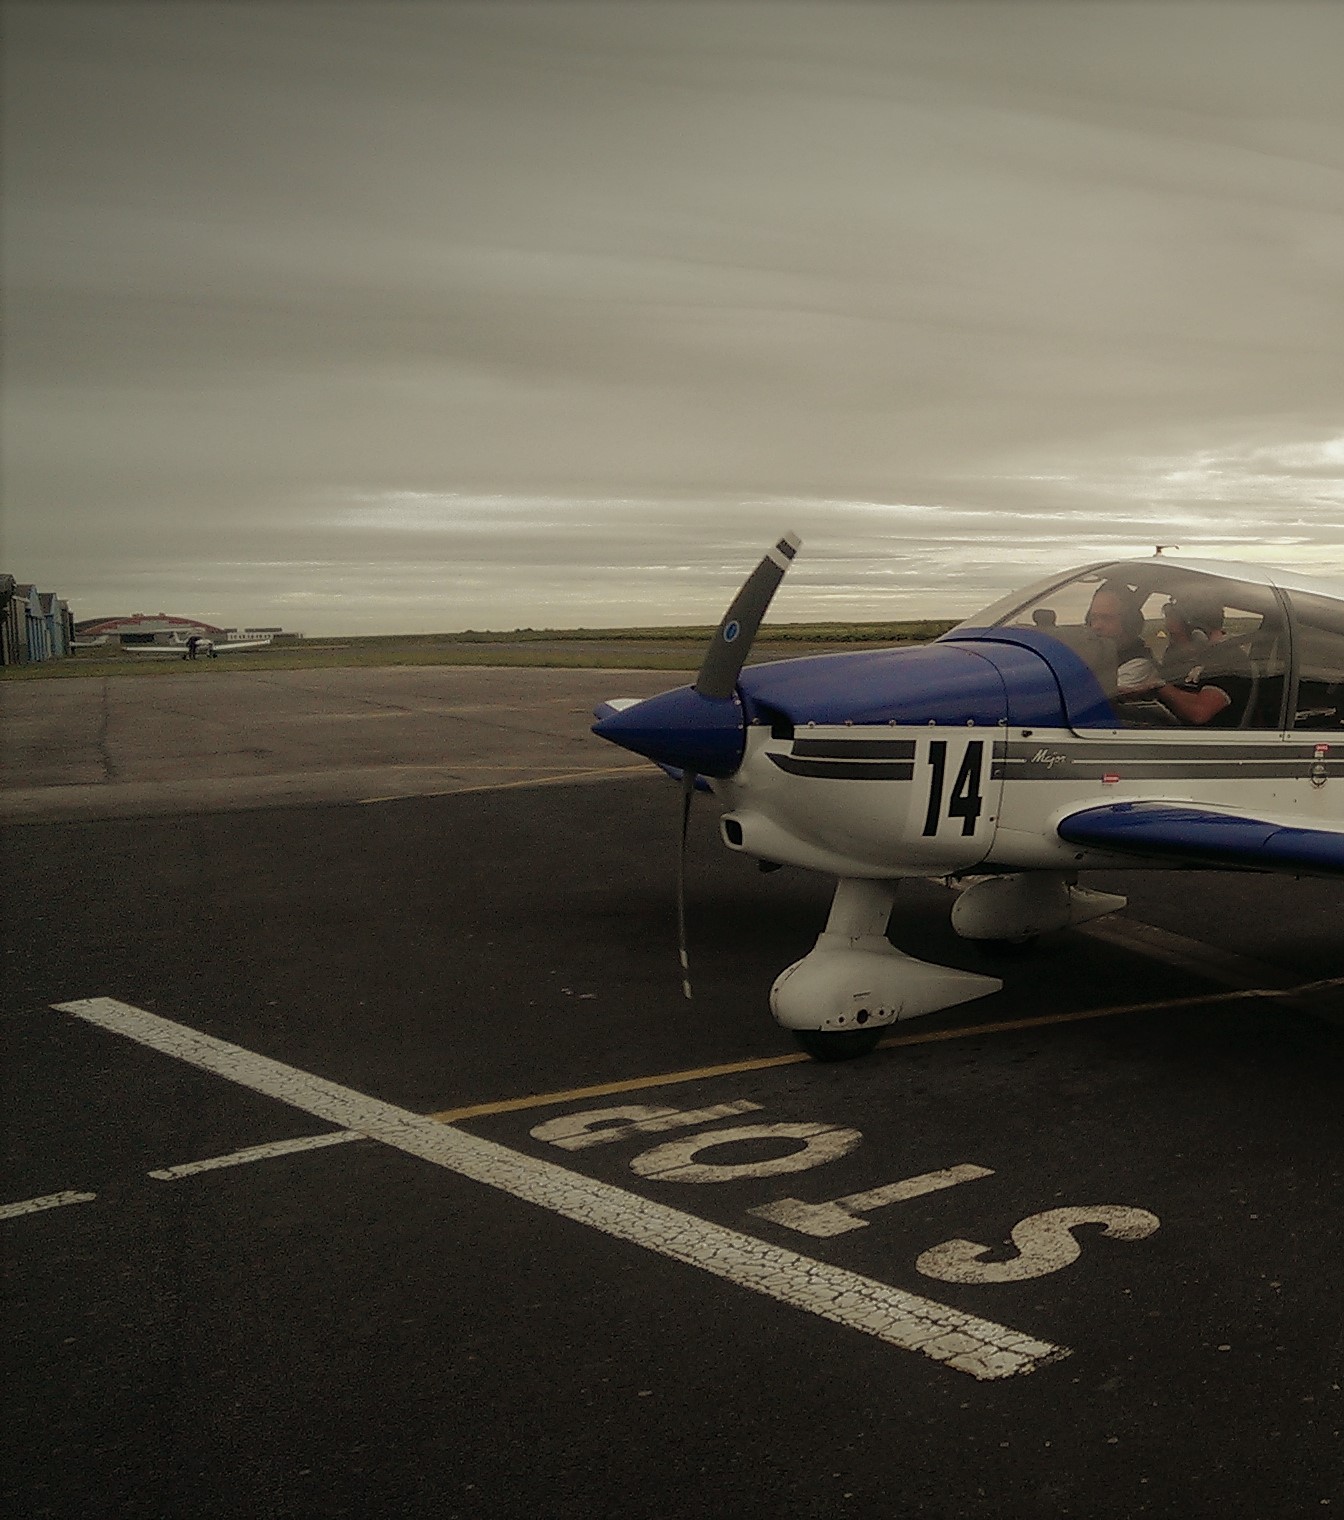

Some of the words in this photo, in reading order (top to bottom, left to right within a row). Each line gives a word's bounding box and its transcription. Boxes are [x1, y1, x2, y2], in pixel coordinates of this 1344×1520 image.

[922, 740, 984, 837] 14
[1030, 748, 1067, 769] Major
[530, 1099, 1161, 1284] STOP
